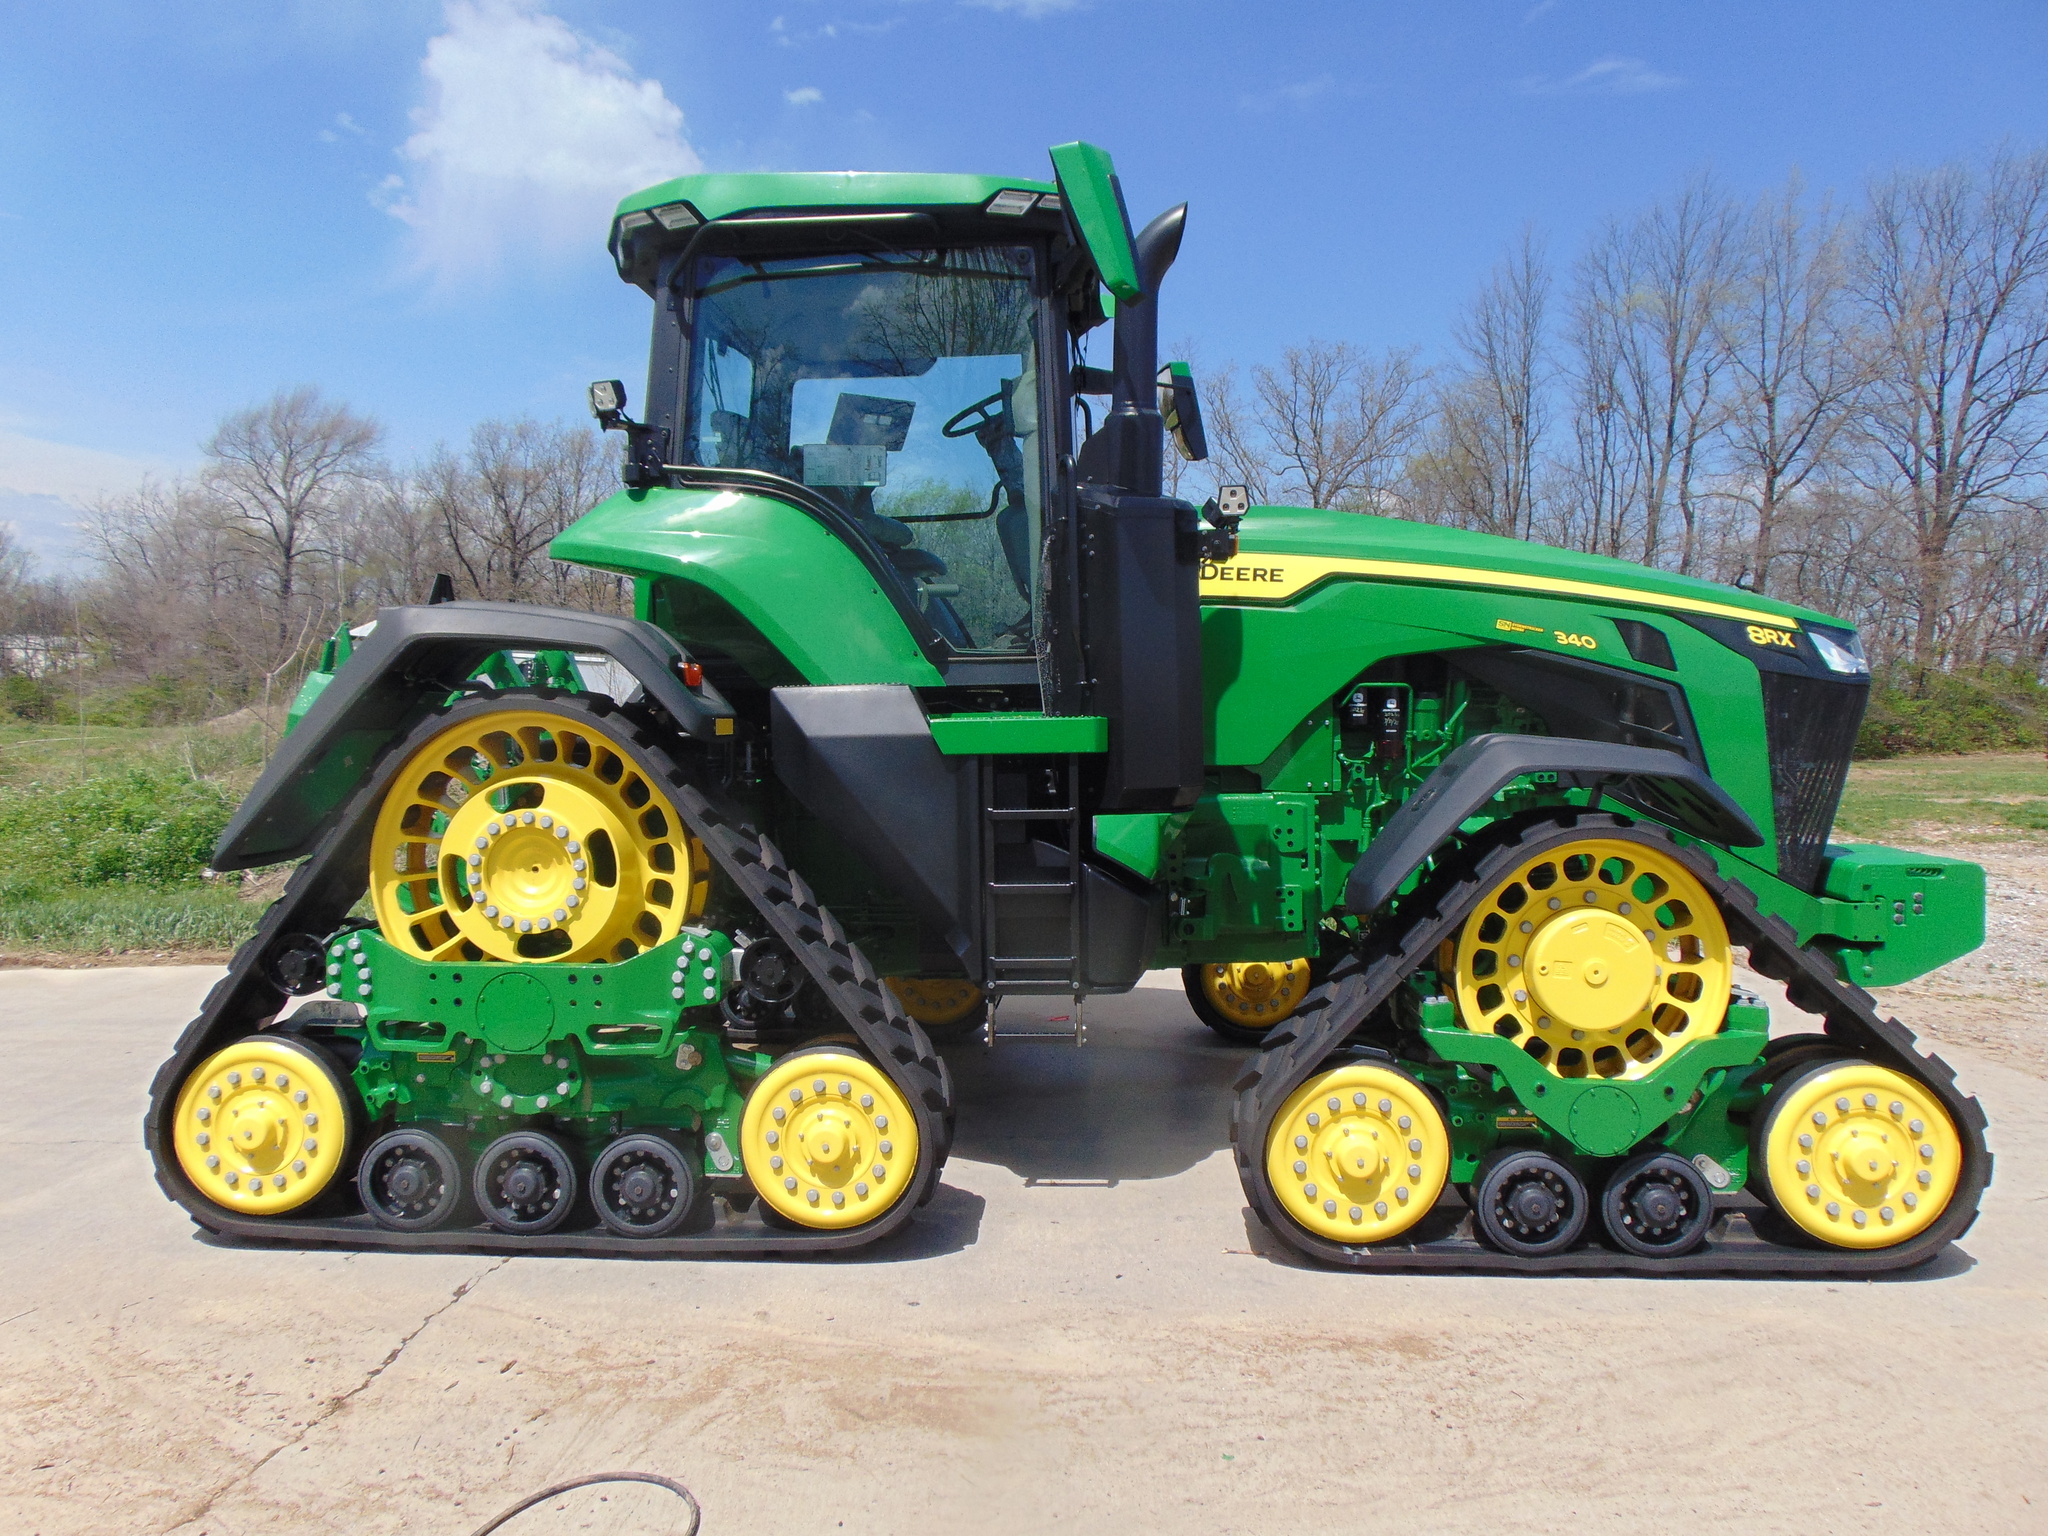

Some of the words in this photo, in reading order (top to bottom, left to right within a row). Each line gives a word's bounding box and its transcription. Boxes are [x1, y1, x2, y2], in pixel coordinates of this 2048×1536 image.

[1200, 563, 1284, 583] DEERE
[1553, 630, 1597, 650] 340
[1746, 625, 1797, 649] 8RX
